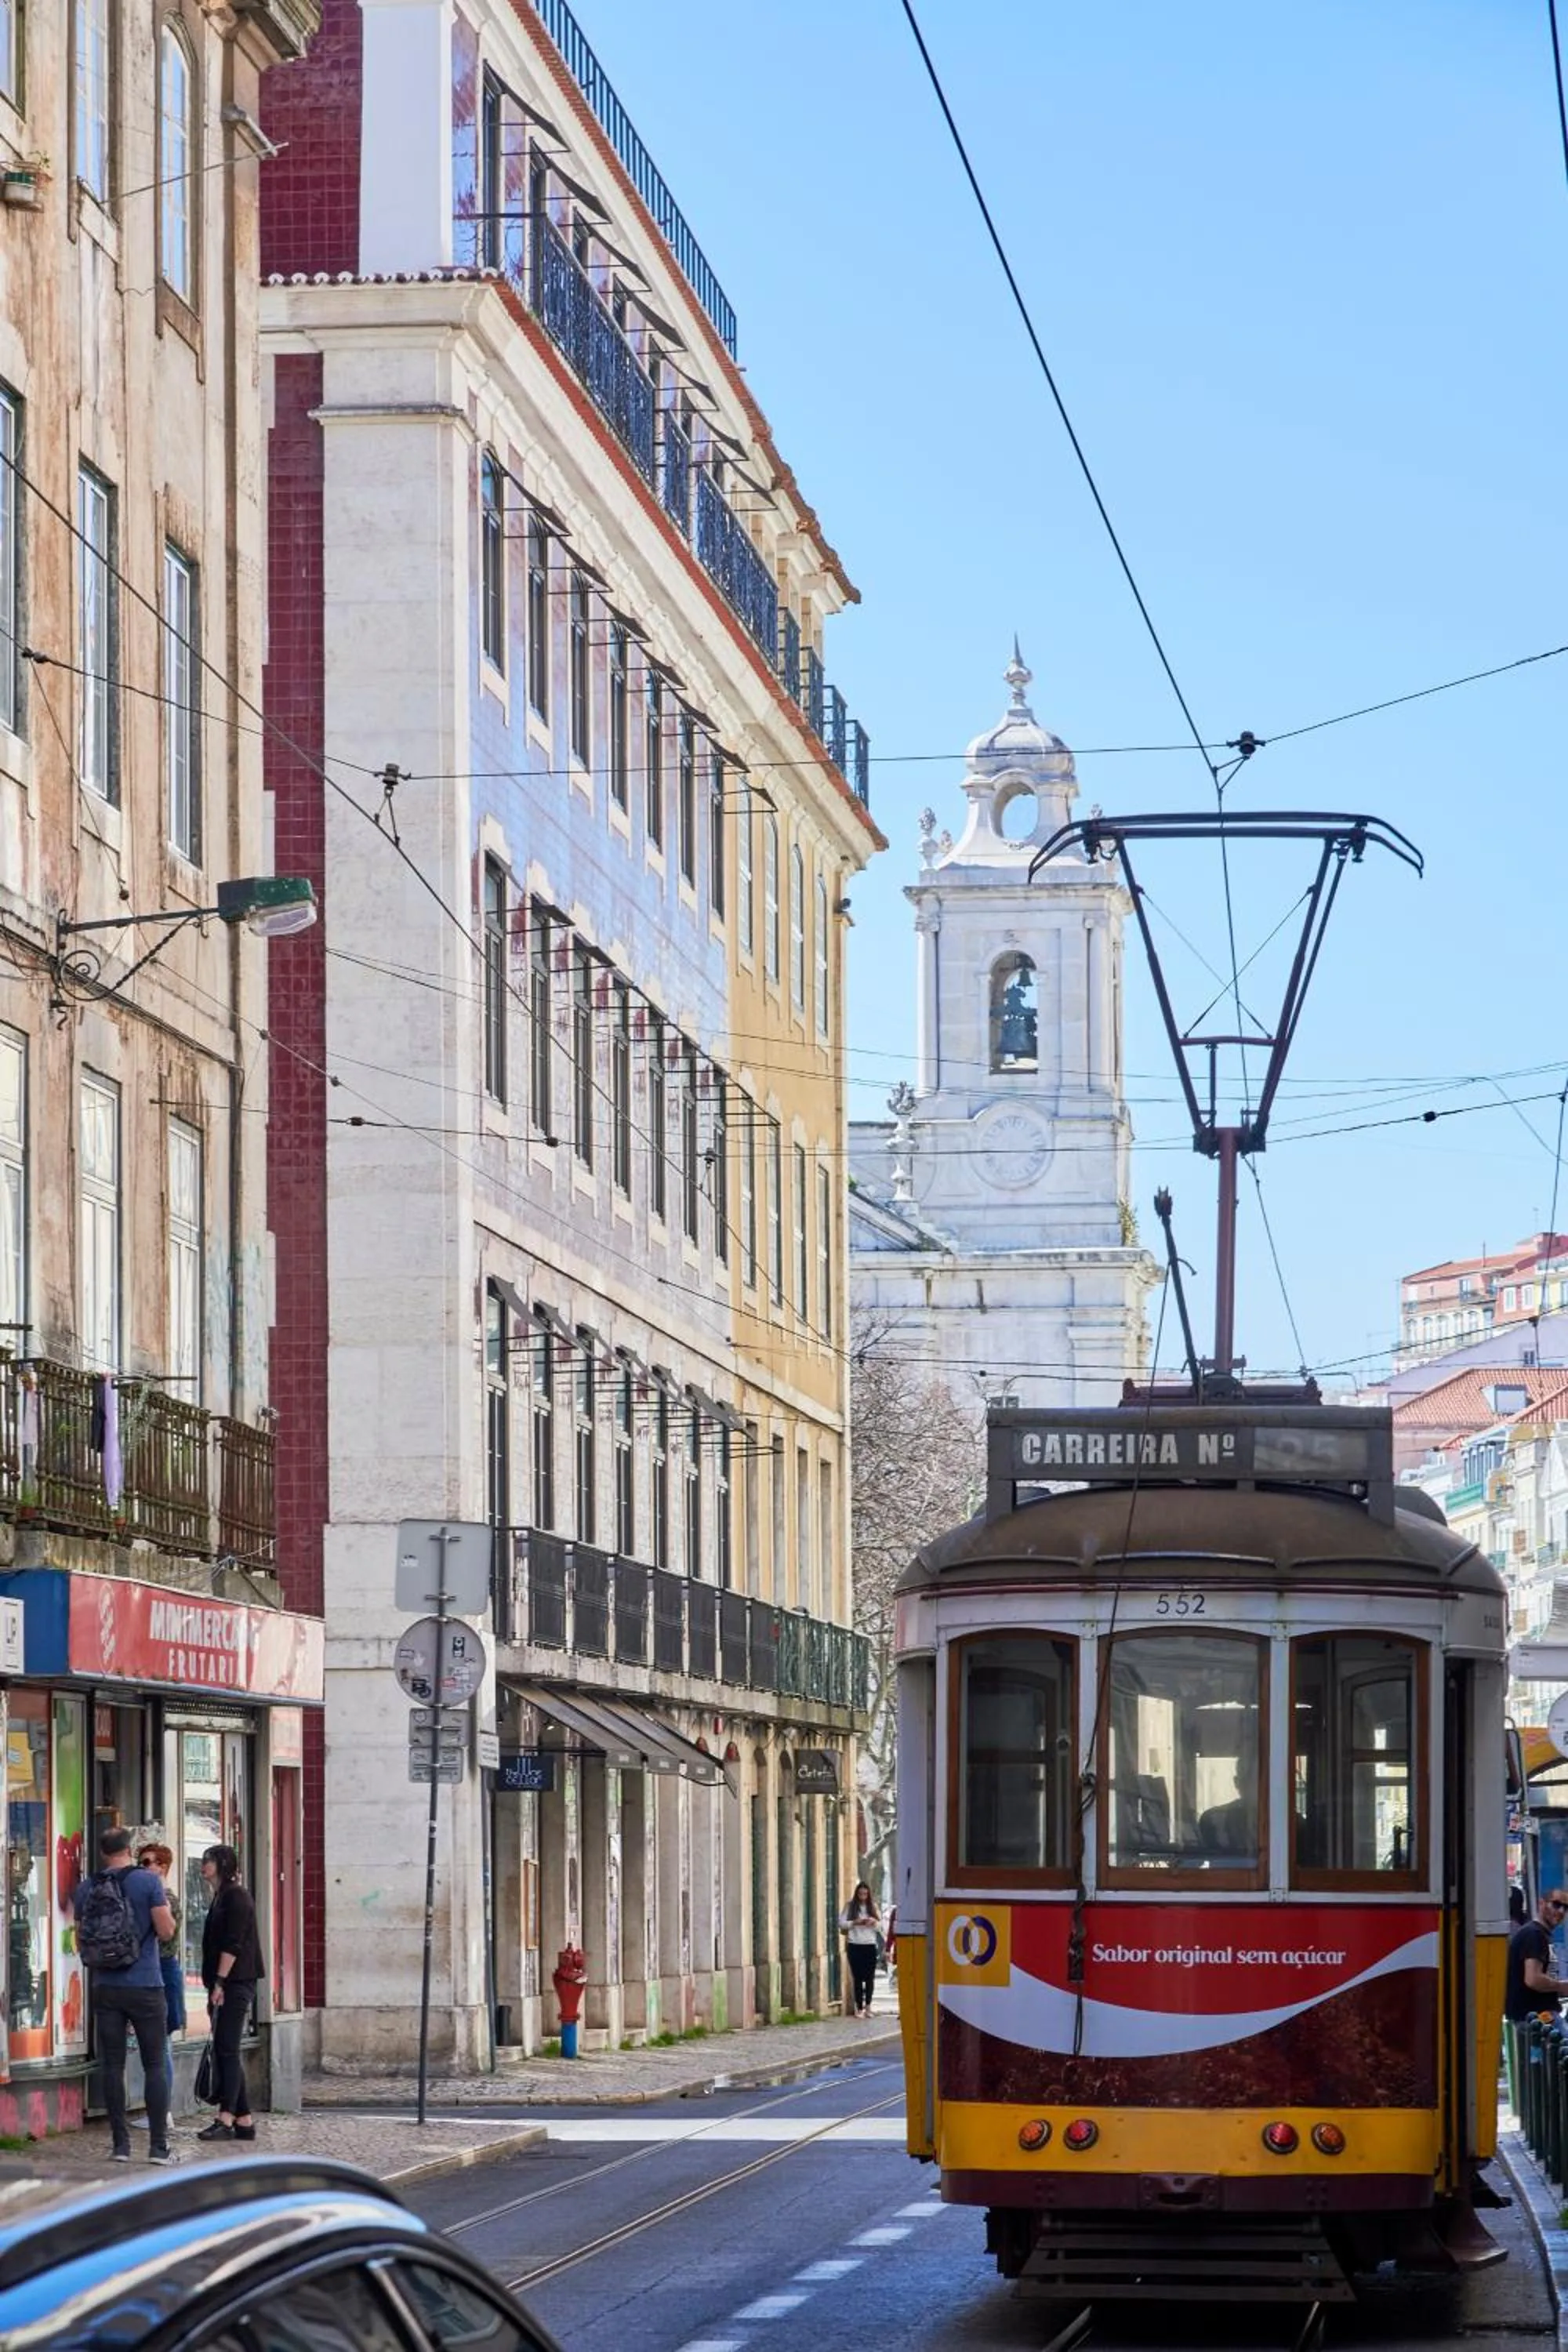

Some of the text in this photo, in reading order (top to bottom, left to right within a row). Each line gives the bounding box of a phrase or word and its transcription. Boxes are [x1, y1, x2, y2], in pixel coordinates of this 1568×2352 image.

[1022, 1433, 1178, 1465] CARREIRA
[1156, 1593, 1205, 1614] 552
[150, 1600, 260, 1653] MINIMERCA
[1092, 1944, 1346, 1969] Sabor original sem açúcar
